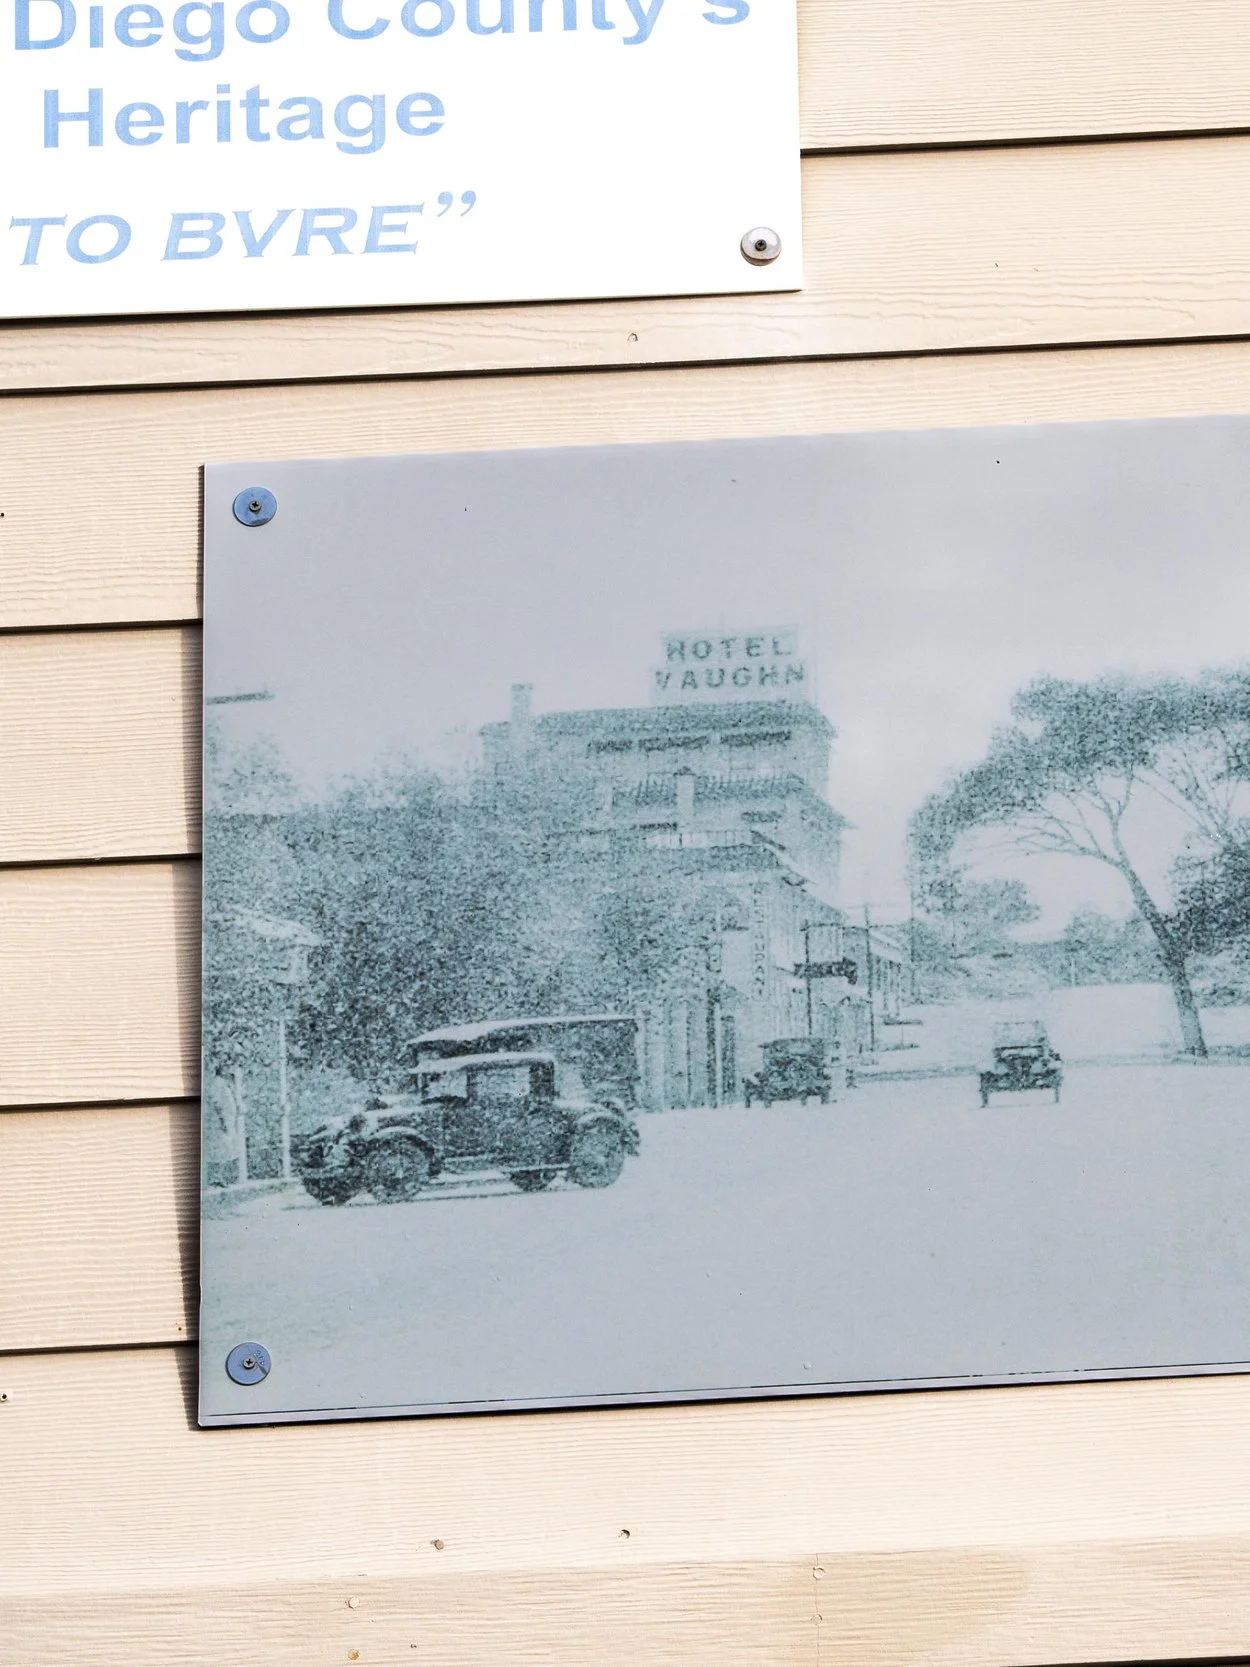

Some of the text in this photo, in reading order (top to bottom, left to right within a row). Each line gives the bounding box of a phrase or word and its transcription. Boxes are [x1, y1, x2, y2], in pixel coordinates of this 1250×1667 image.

[14, 0, 751, 62] Diego Countys
[42, 83, 446, 155] Heritage
[8, 212, 132, 266] TO
[665, 635, 793, 662] HOTEL
[654, 663, 804, 691] VAUGHN
